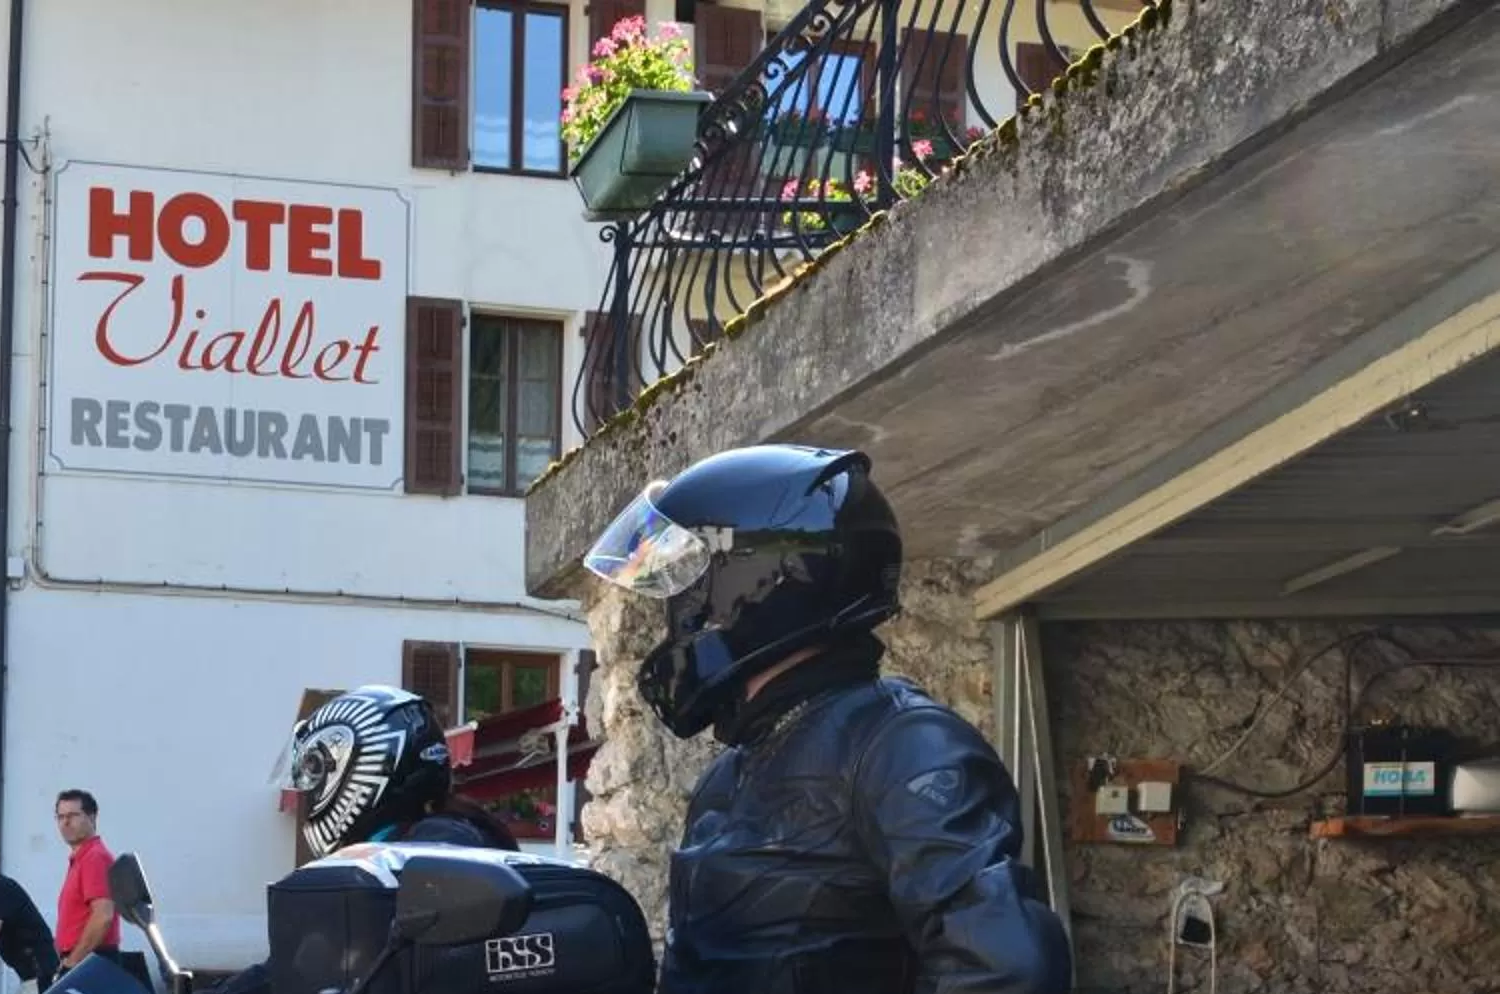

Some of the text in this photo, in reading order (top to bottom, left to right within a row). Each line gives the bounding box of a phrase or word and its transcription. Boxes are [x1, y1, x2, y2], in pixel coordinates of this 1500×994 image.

[88, 187, 381, 280] HOTEL
[77, 271, 381, 384] Viallet
[70, 397, 390, 465] RESTAURANT
